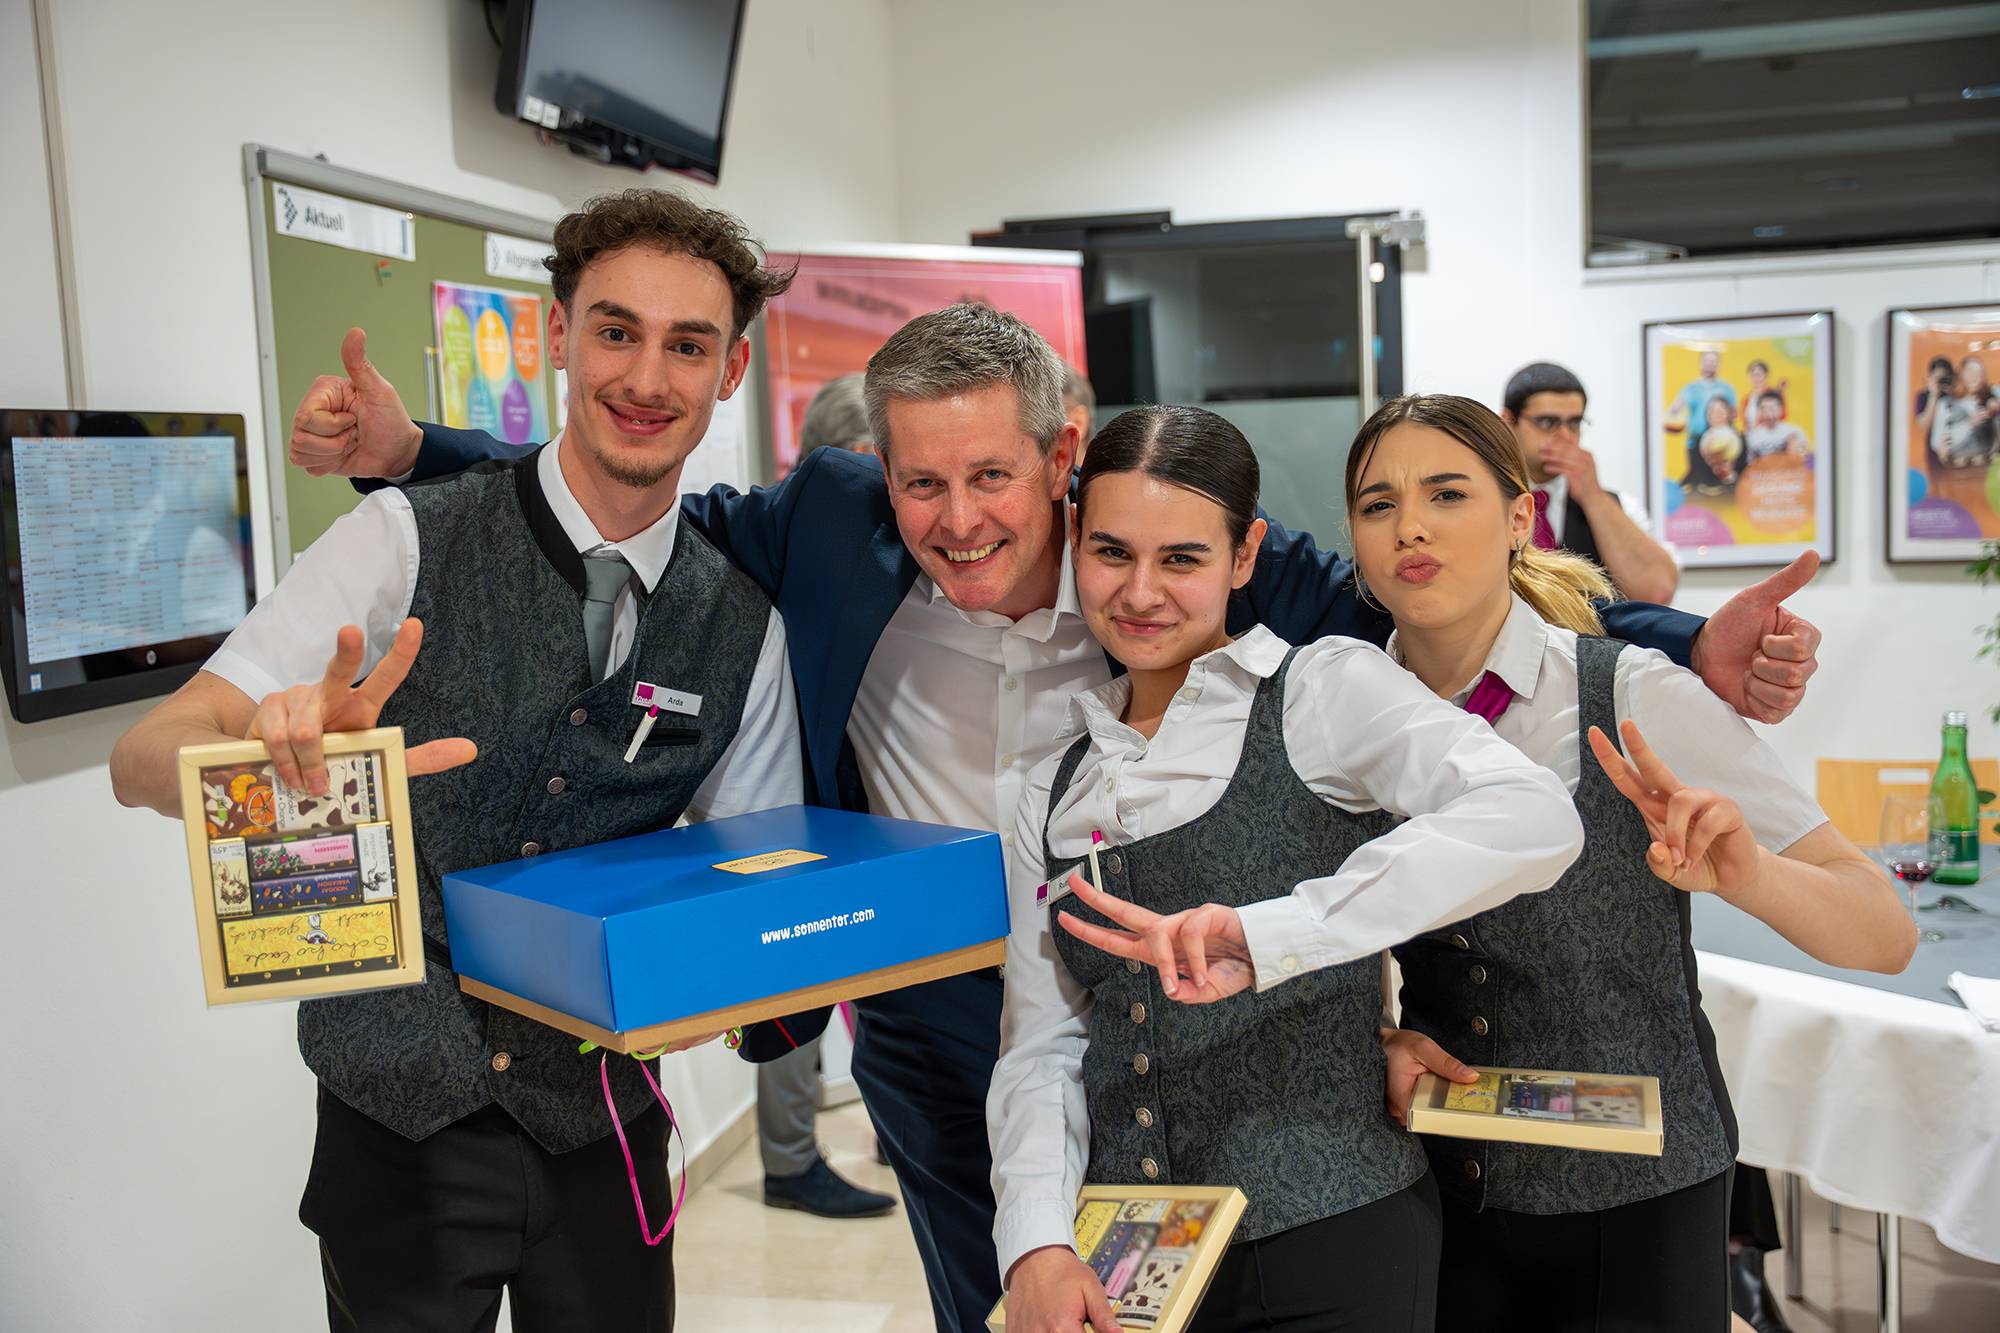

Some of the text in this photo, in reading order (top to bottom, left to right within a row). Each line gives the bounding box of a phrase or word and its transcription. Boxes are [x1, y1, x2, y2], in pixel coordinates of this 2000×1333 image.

[304, 206, 345, 232] Aktuell
[667, 697, 684, 706] Arda
[761, 908, 875, 944] www.sonnentor.com
